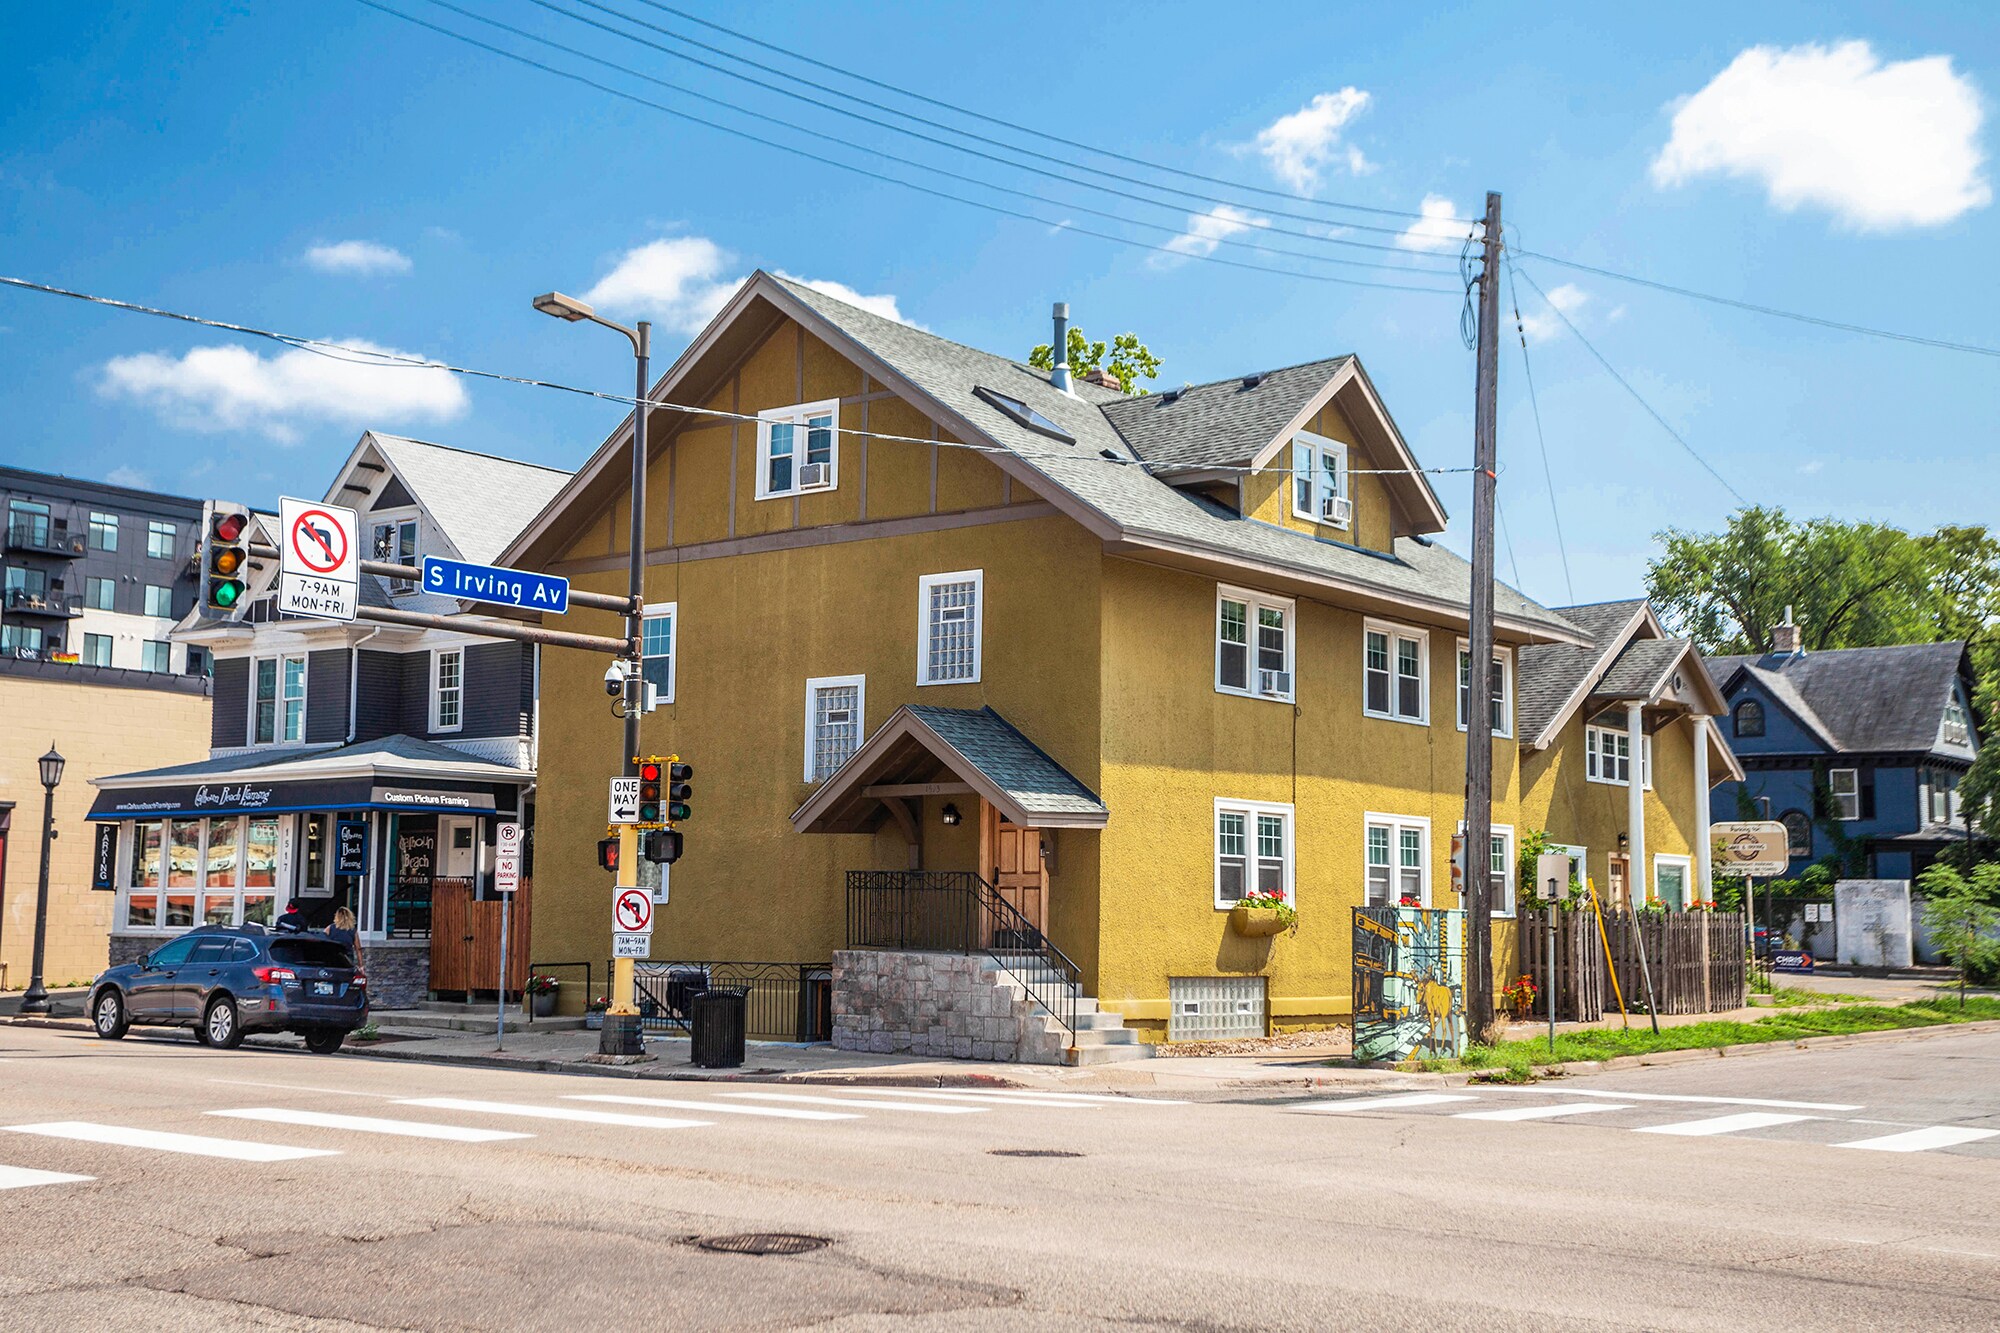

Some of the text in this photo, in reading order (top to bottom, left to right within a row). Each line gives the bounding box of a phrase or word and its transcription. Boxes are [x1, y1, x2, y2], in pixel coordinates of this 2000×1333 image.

[299, 579, 340, 597] 7-9AM
[430, 565, 561, 605] S Irving Av
[291, 595, 345, 614] MON-FRI
[614, 781, 638, 793] ONE
[219, 786, 241, 805] Beach
[384, 792, 469, 807] Custom Picture Framing
[613, 794, 638, 805] WAY
[99, 826, 110, 880] PARKING
[342, 842, 361, 856] Beach
[618, 937, 646, 945] 7AM-9AM
[618, 946, 646, 955] MON-FRI
